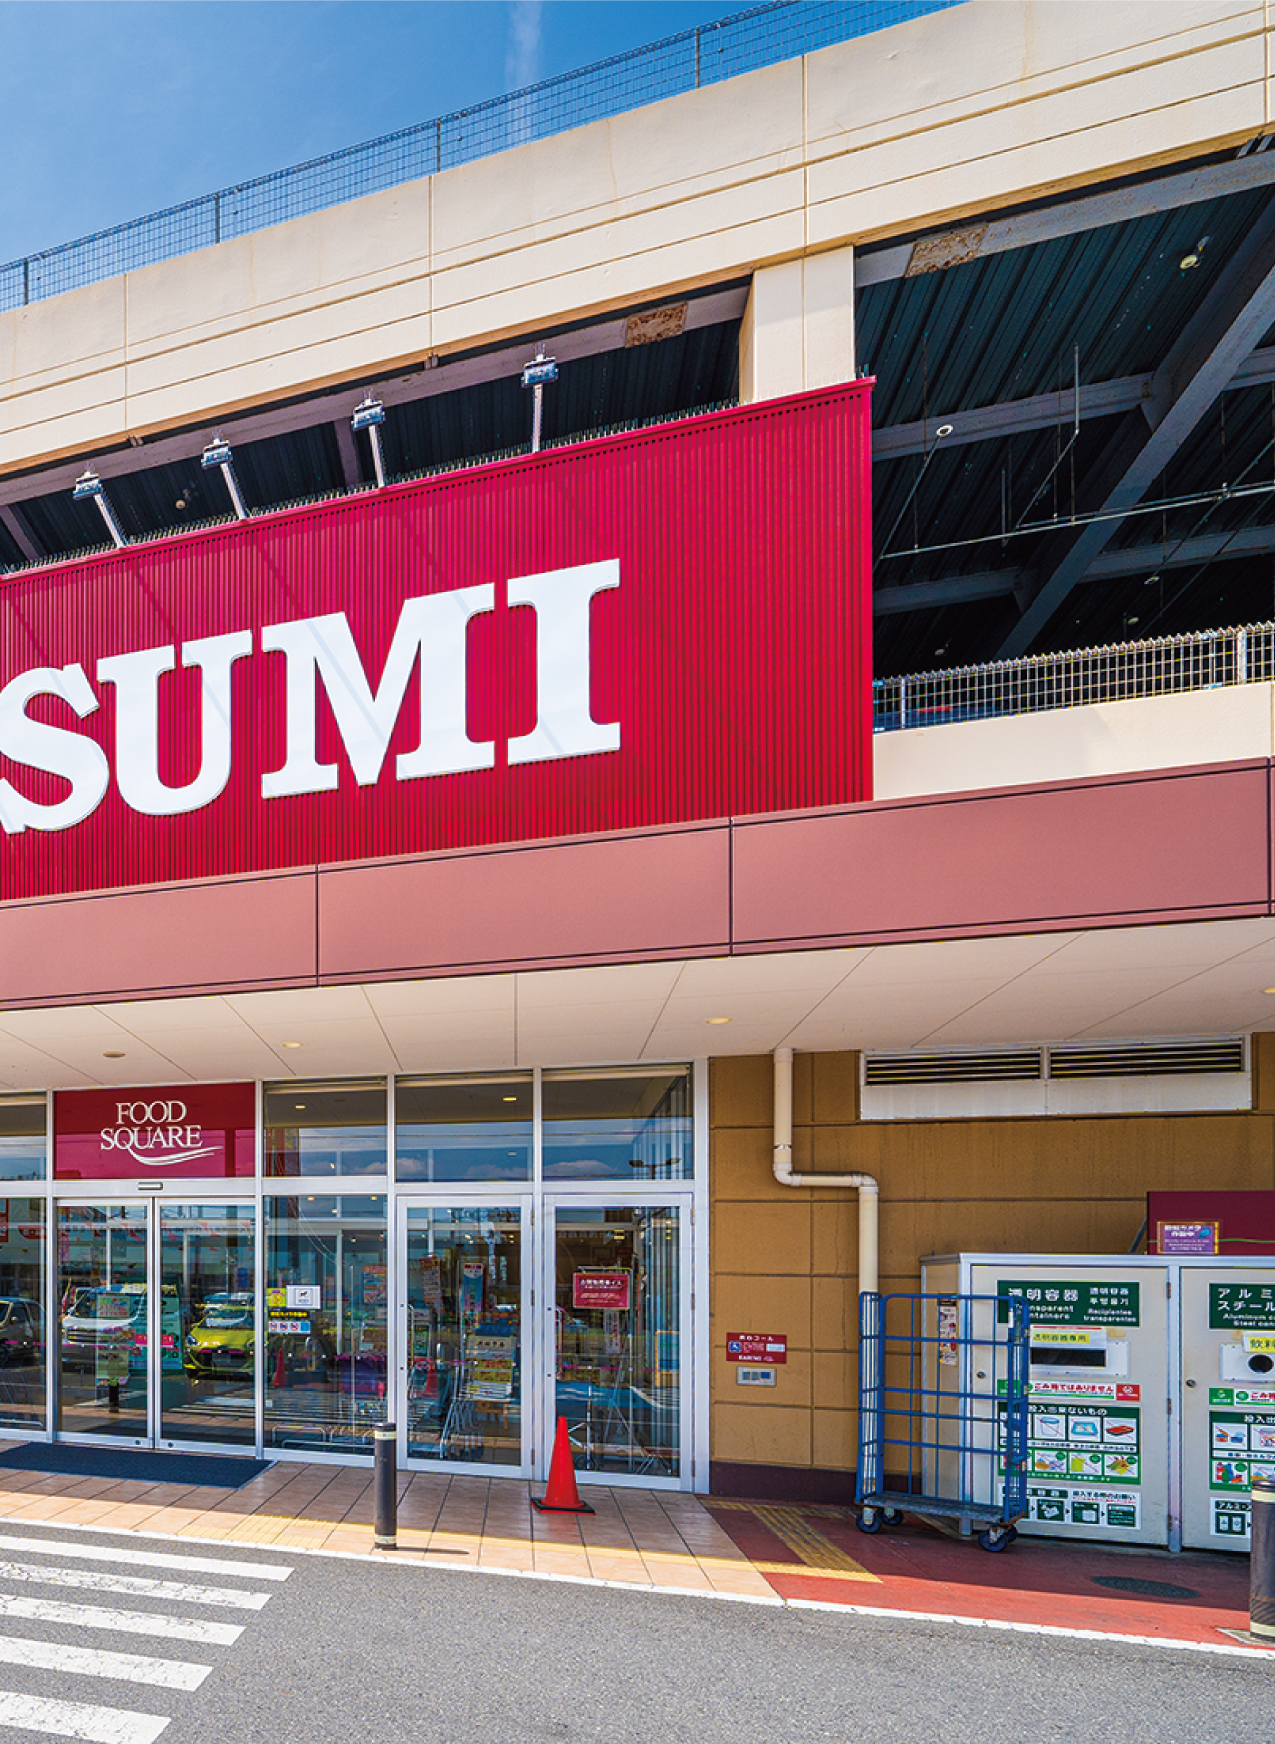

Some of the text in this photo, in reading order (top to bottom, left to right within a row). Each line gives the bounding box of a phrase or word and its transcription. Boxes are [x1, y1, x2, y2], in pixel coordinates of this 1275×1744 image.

[115, 1099, 188, 1125] FOOD
[100, 1124, 204, 1151] SQUARE
[1217, 1287, 1274, 1300] アルミ
